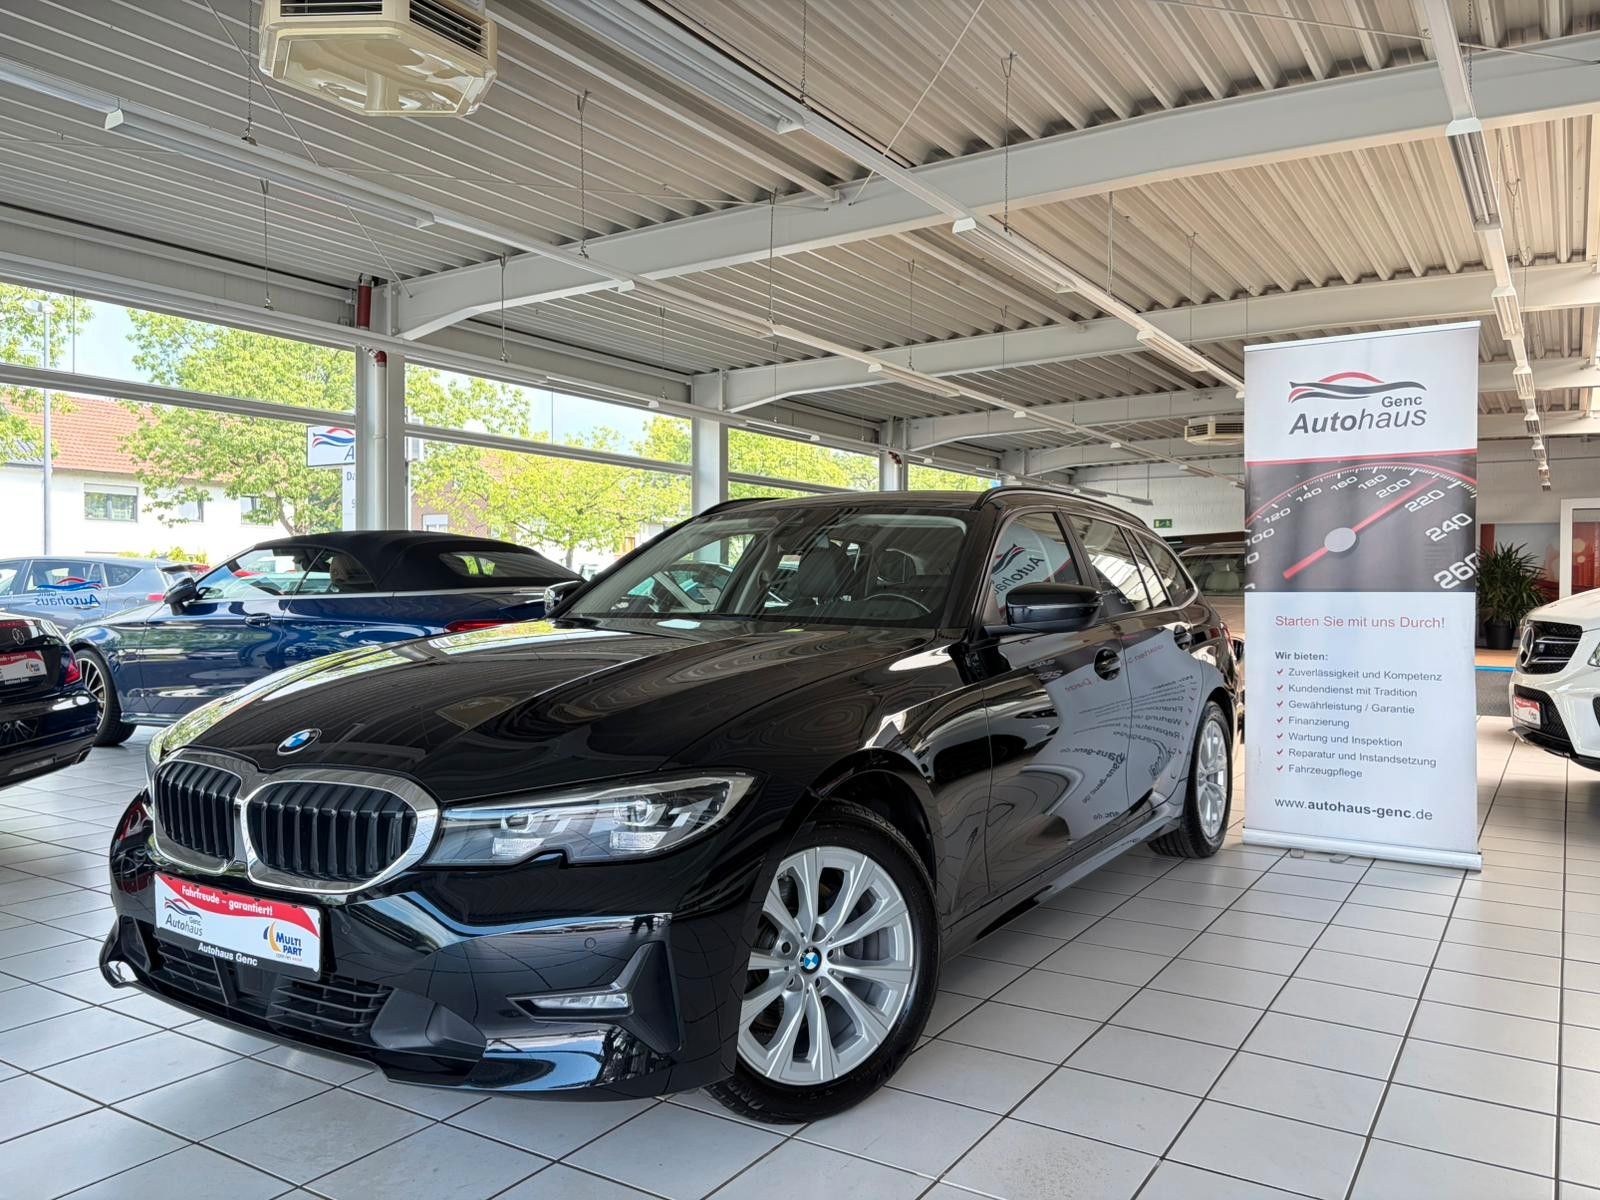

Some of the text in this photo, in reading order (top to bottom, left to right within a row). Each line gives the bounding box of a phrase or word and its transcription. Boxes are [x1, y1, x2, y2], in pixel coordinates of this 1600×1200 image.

[1381, 395, 1423, 408] Genc
[1289, 409, 1427, 435] Autohaus
[1330, 475, 1358, 492] 160
[1357, 474, 1388, 490] 180
[1375, 478, 1412, 499] 200
[1295, 487, 1322, 502] 140
[1404, 489, 1446, 513] 220
[1264, 507, 1291, 524] 120
[1425, 513, 1473, 542] 240
[1245, 528, 1275, 546] 100
[1275, 616, 1445, 629] Starten Sie mit uns Durch!
[1275, 651, 1329, 661] Wir bieten:
[1288, 668, 1443, 682] Zuverlässigkeit und Kompetenz
[1288, 684, 1418, 697] Kundendienst mit Tradition
[1288, 700, 1362, 713] Gewährleistung
[1371, 704, 1415, 714] Garantie
[1288, 716, 1350, 729] Finanzierung
[1288, 732, 1402, 748] Wartung und Inspektion
[1288, 749, 1437, 768] Reparatur und Instandsetzung
[1288, 765, 1363, 778] Fahrzeugpflege
[1274, 798, 1433, 821] www.autohaus-genc.de
[182, 885, 220, 904] Fahrfreude
[228, 901, 273, 916] garantiert!
[165, 913, 202, 936] Autohaus
[189, 917, 201, 925] Genc
[276, 932, 301, 946] MULTI
[198, 942, 234, 961] Autohaus
[236, 953, 258, 966] Genc
[283, 945, 302, 956] PART
